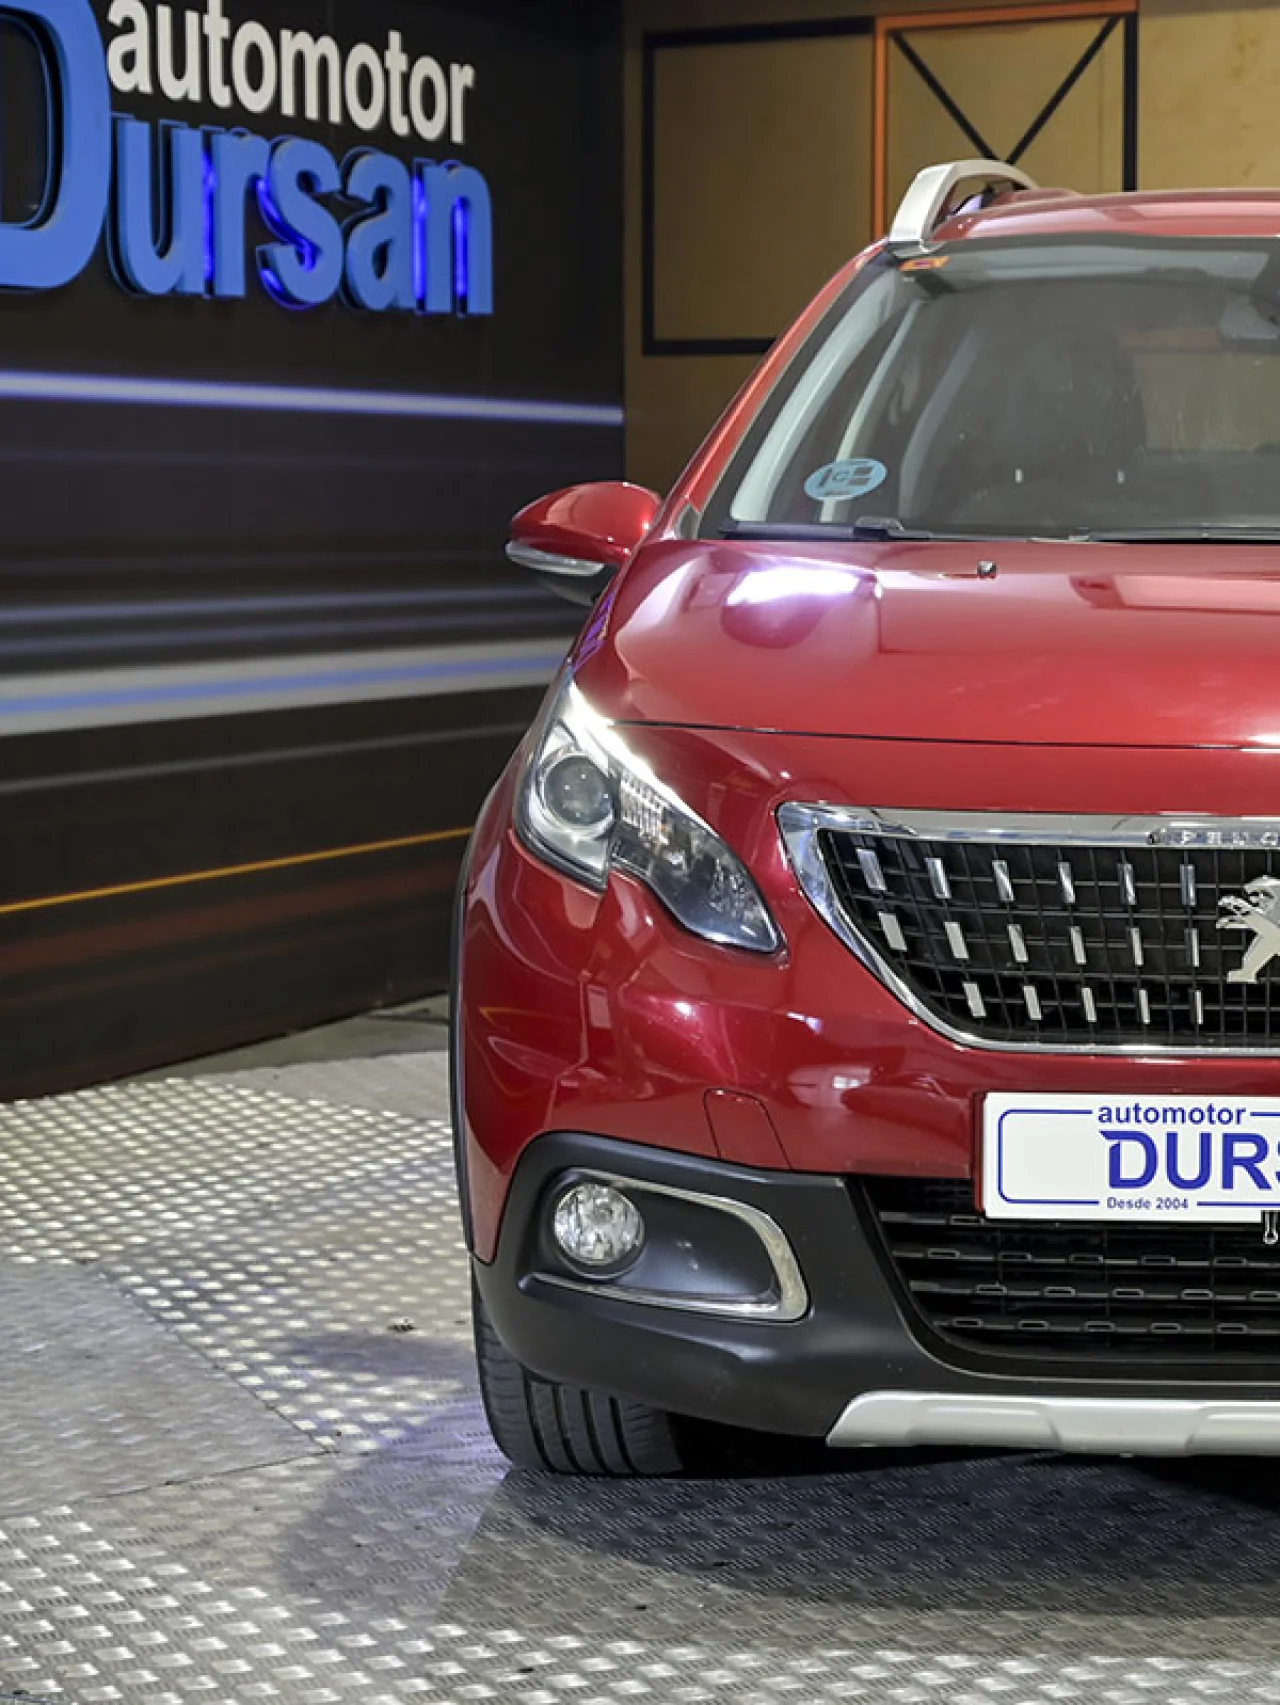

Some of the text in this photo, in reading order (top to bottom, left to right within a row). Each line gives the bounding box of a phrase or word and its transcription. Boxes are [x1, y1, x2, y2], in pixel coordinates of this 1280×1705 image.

[106, 0, 475, 144] automotor
[1098, 1103, 1246, 1125] automotor
[1107, 1197, 1189, 1209] Desde 2004
